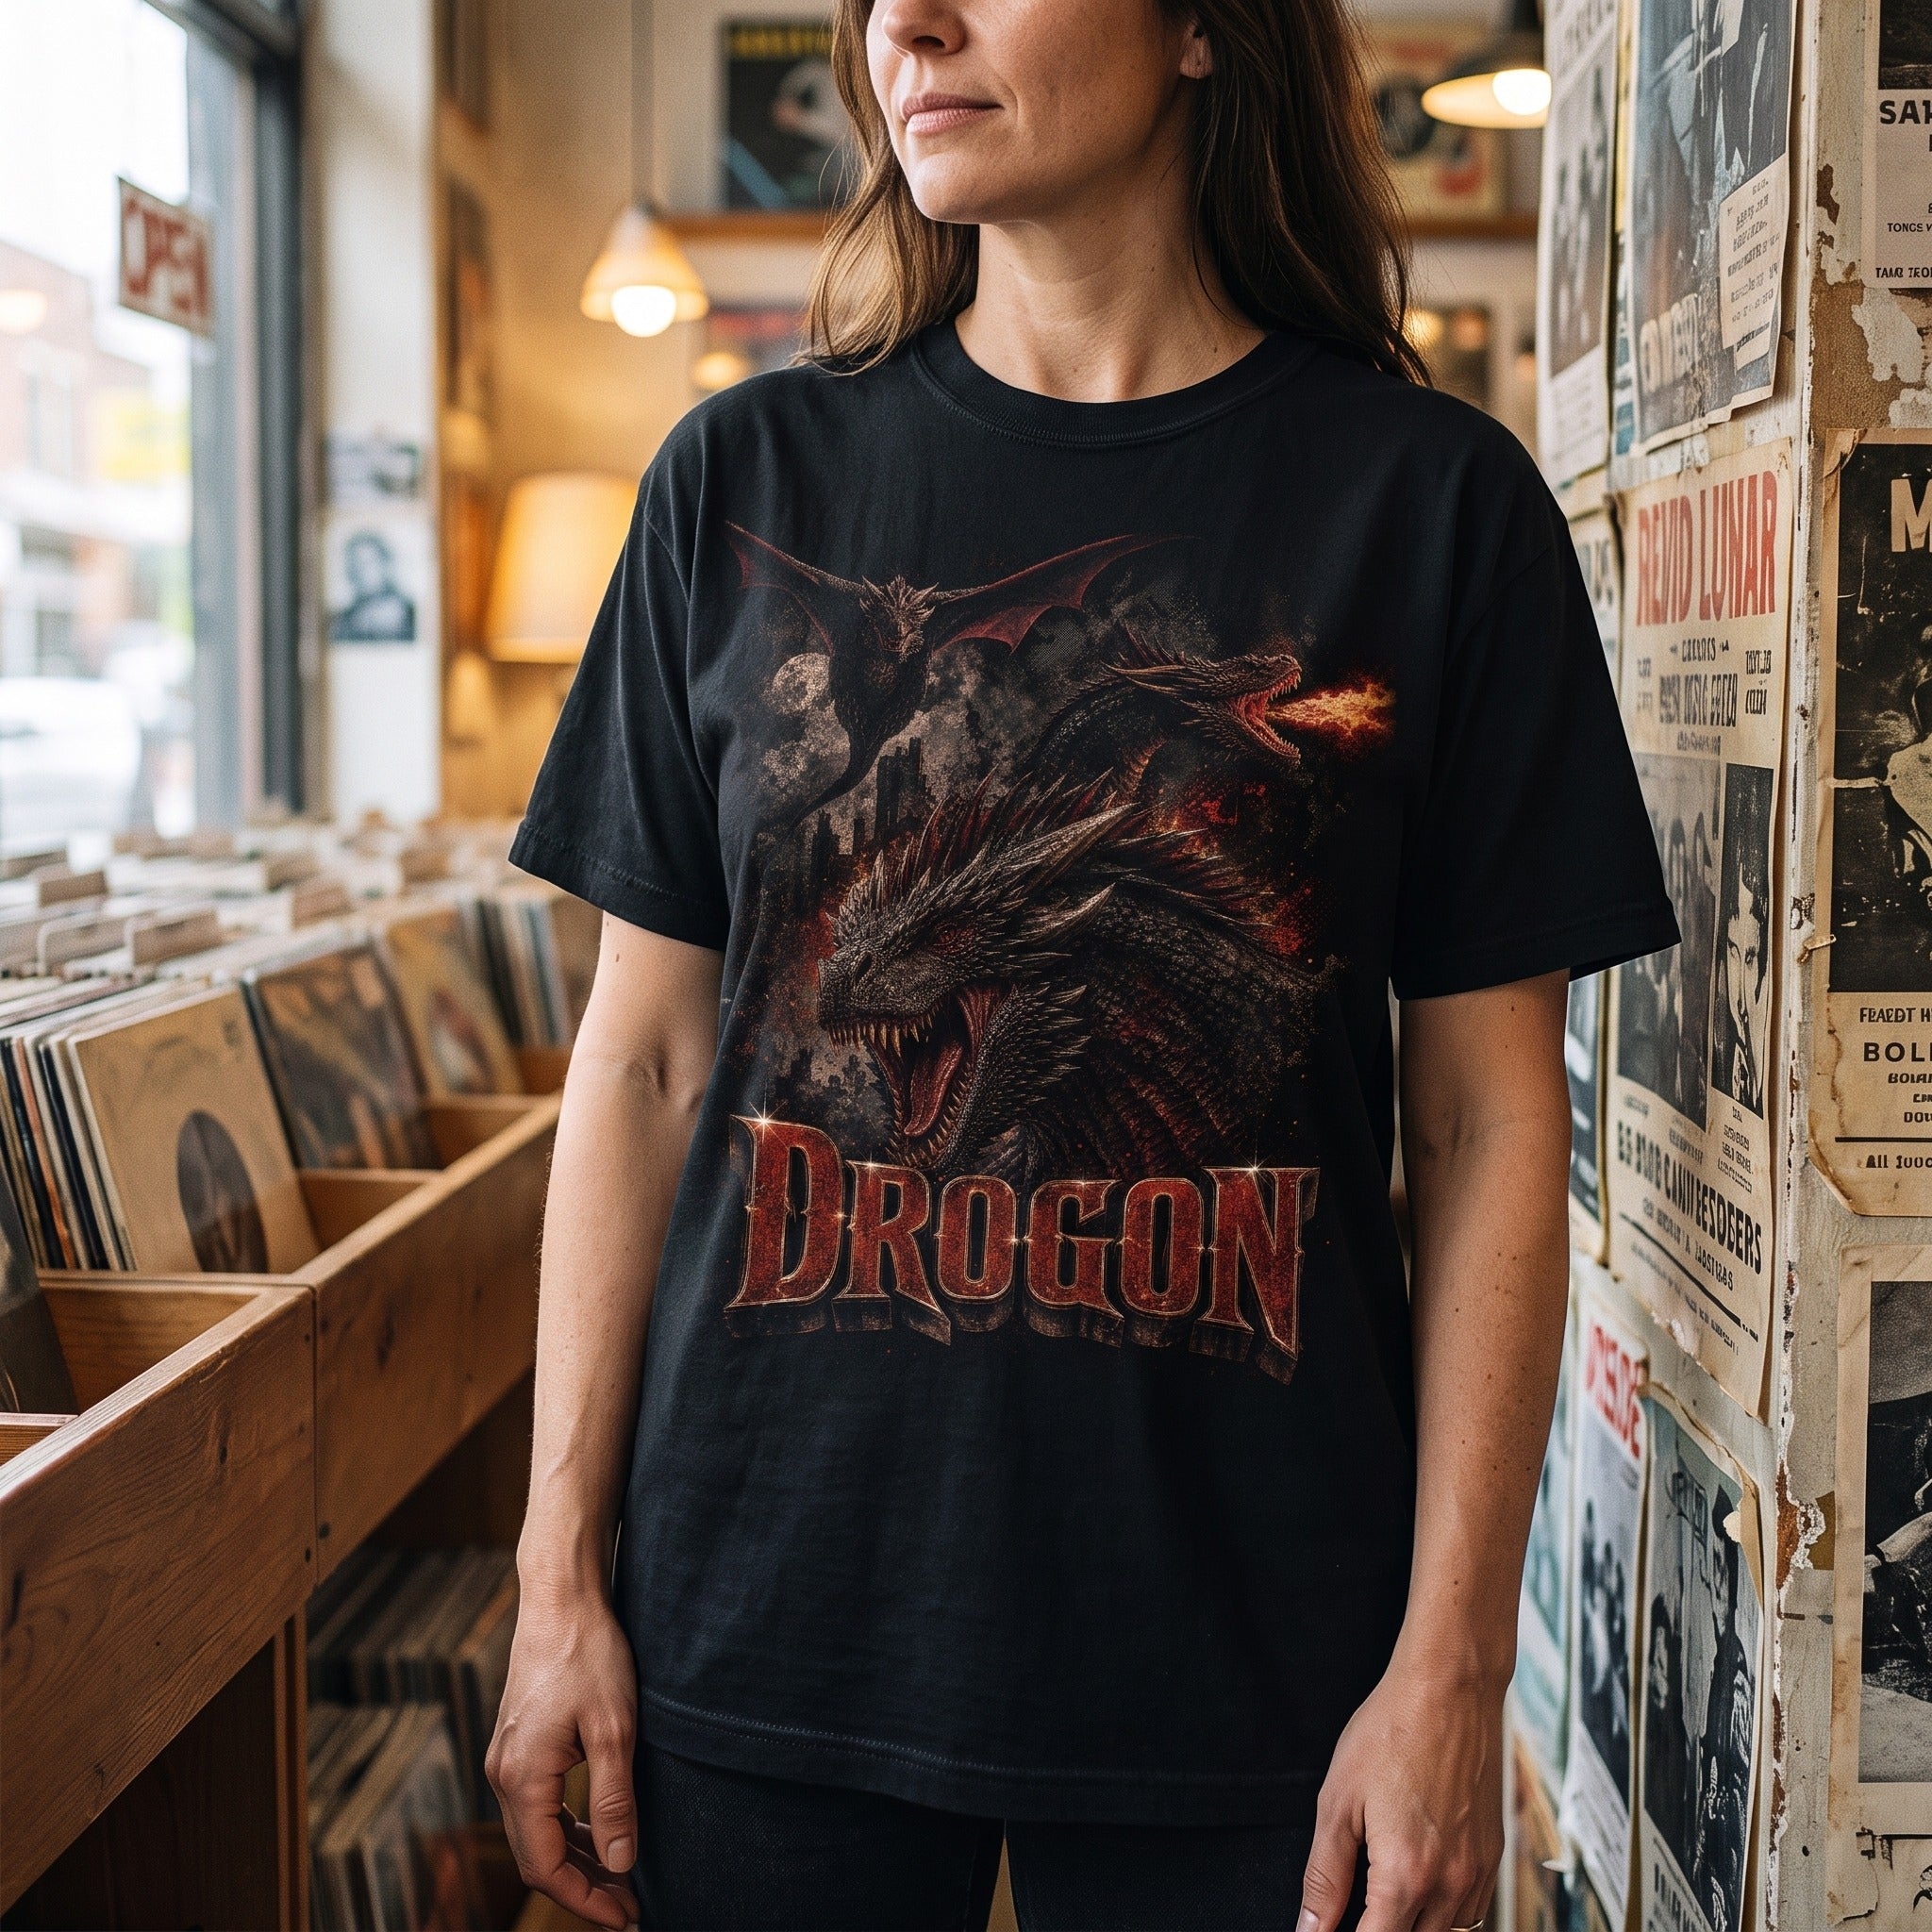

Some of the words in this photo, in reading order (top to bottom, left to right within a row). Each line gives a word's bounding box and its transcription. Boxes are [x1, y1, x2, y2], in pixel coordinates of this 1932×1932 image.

[1699, 470, 1777, 622] LUNAR
[1863, 1042, 1932, 1062] BOL
[723, 1115, 1321, 1362] DROGON
